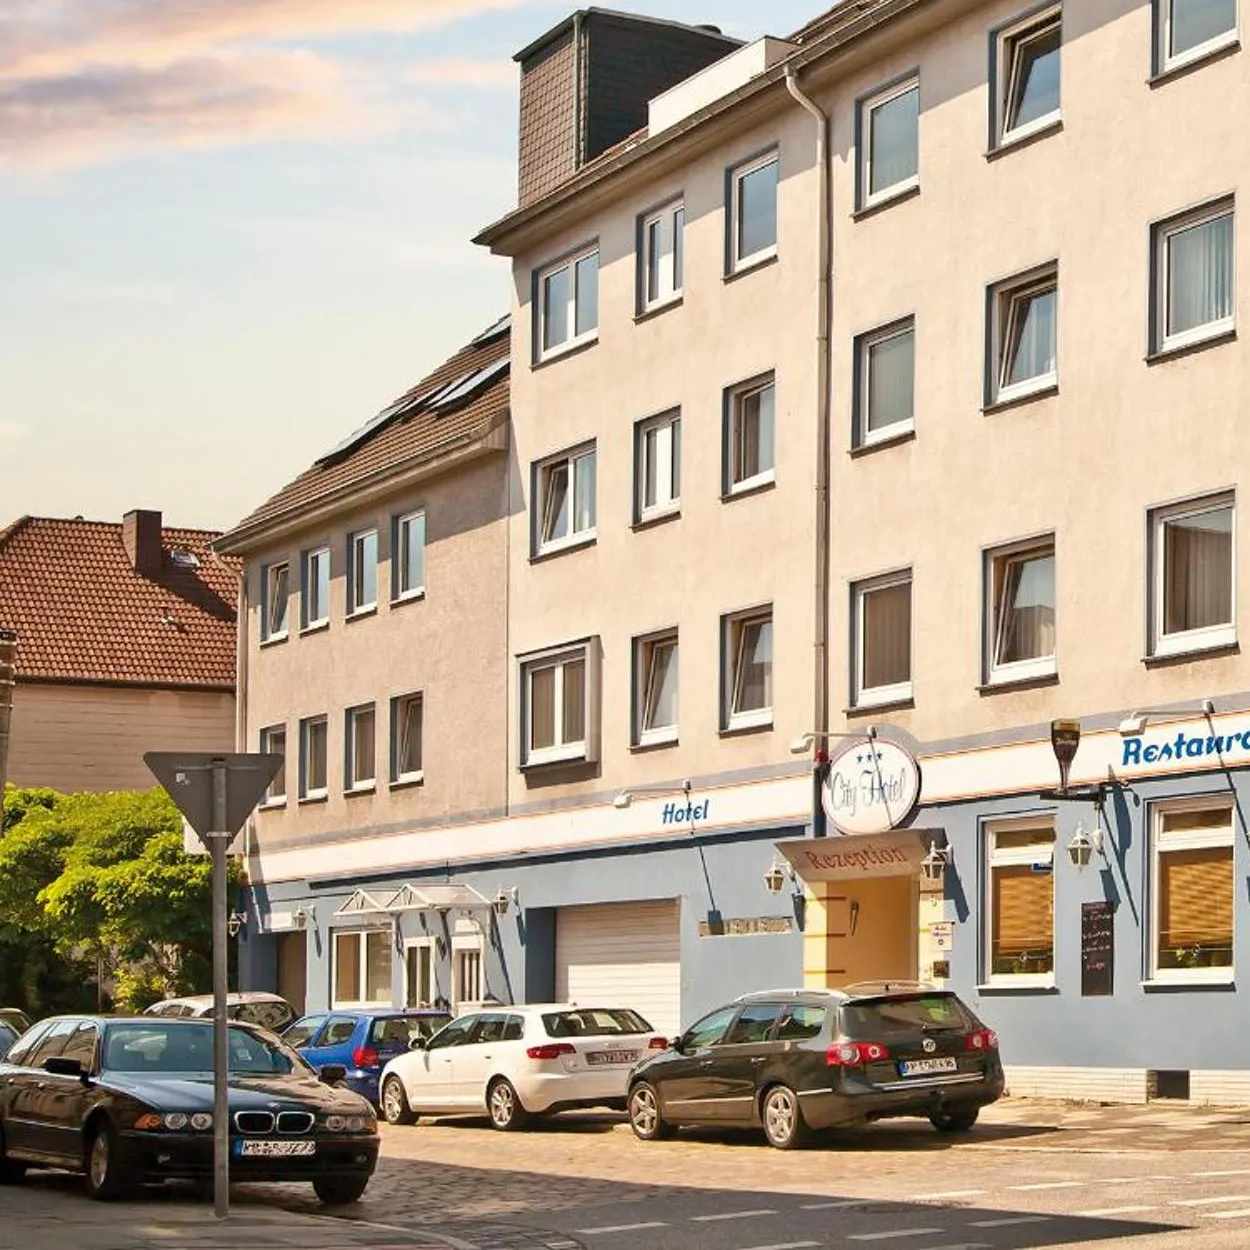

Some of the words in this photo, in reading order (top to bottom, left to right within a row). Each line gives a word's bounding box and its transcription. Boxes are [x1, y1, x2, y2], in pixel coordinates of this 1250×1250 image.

[831, 771, 857, 817] City
[860, 768, 906, 807] Hotel
[662, 799, 709, 824] Hotel
[804, 845, 906, 871] Rezeption
